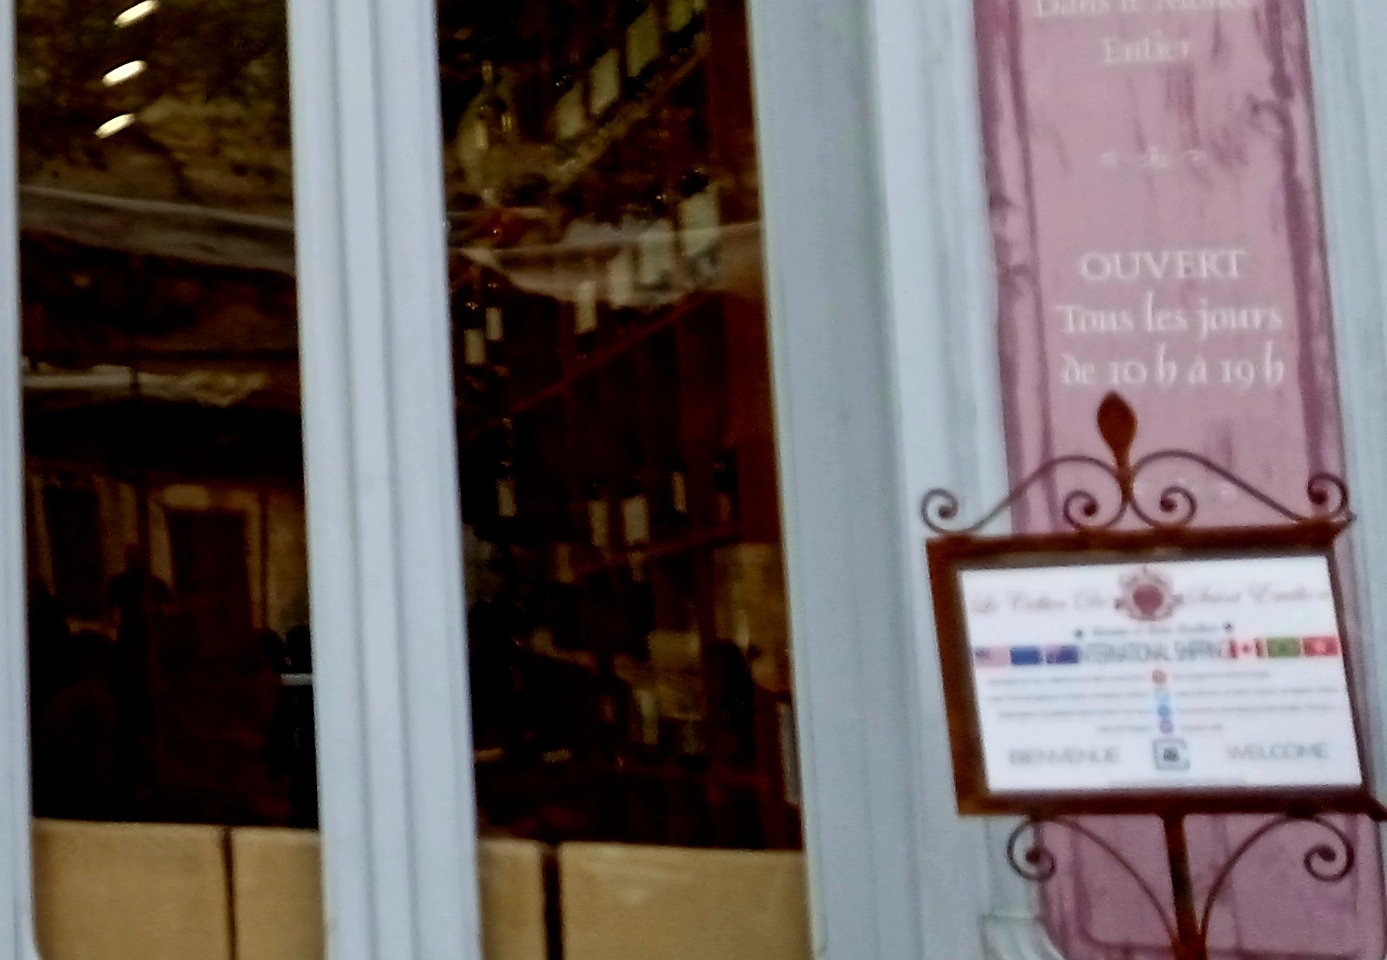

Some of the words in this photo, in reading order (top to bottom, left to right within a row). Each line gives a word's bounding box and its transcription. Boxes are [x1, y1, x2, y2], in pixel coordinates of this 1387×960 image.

[1080, 249, 1247, 281] OUVERT
[1056, 303, 1135, 335] Tous
[1144, 290, 1188, 332] les
[1197, 299, 1284, 339] jours
[1061, 352, 1096, 385] de
[1221, 358, 1255, 387] 19
[1226, 742, 1330, 762] WELCOME
